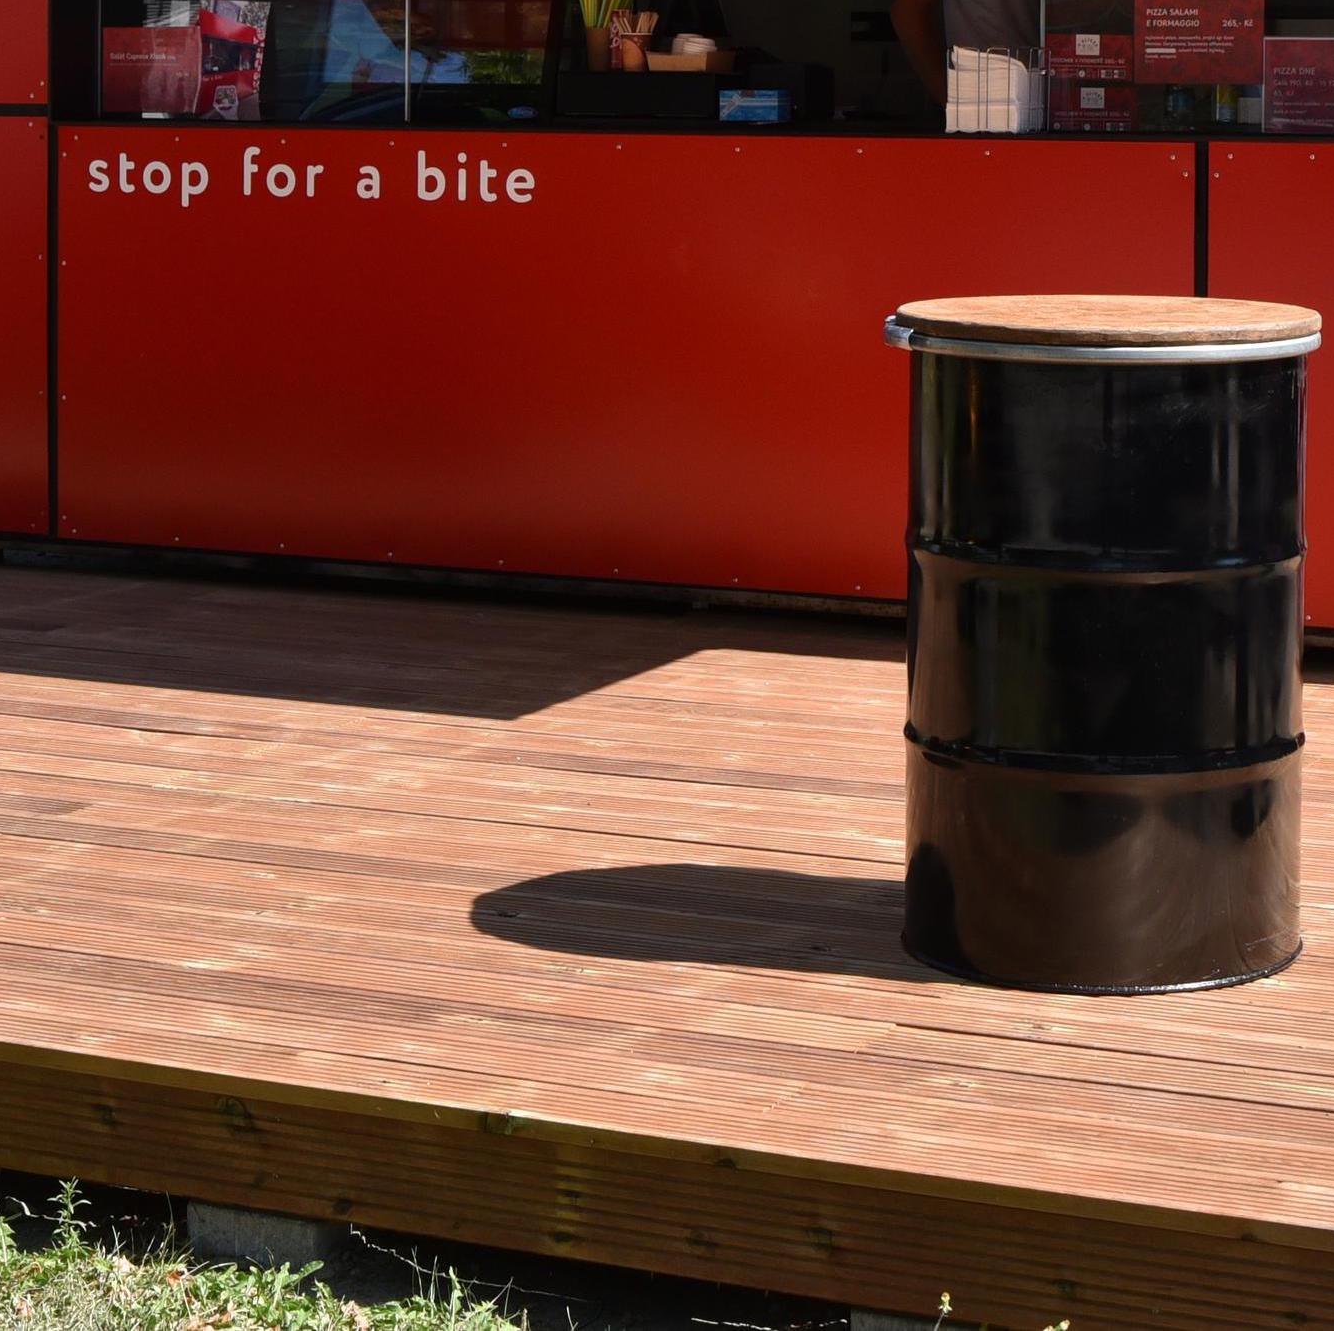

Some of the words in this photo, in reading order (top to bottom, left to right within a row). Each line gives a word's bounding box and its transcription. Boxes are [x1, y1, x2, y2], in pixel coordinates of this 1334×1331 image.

[1146, 8, 1168, 17] PIZZA
[1169, 8, 1199, 16] SALAMI
[1152, 19, 1200, 27] FORMAGGIO
[1273, 67, 1297, 76] PIZZA
[88, 152, 209, 207] stop
[242, 146, 324, 198] for
[356, 163, 381, 200] a
[417, 150, 536, 204] bite
